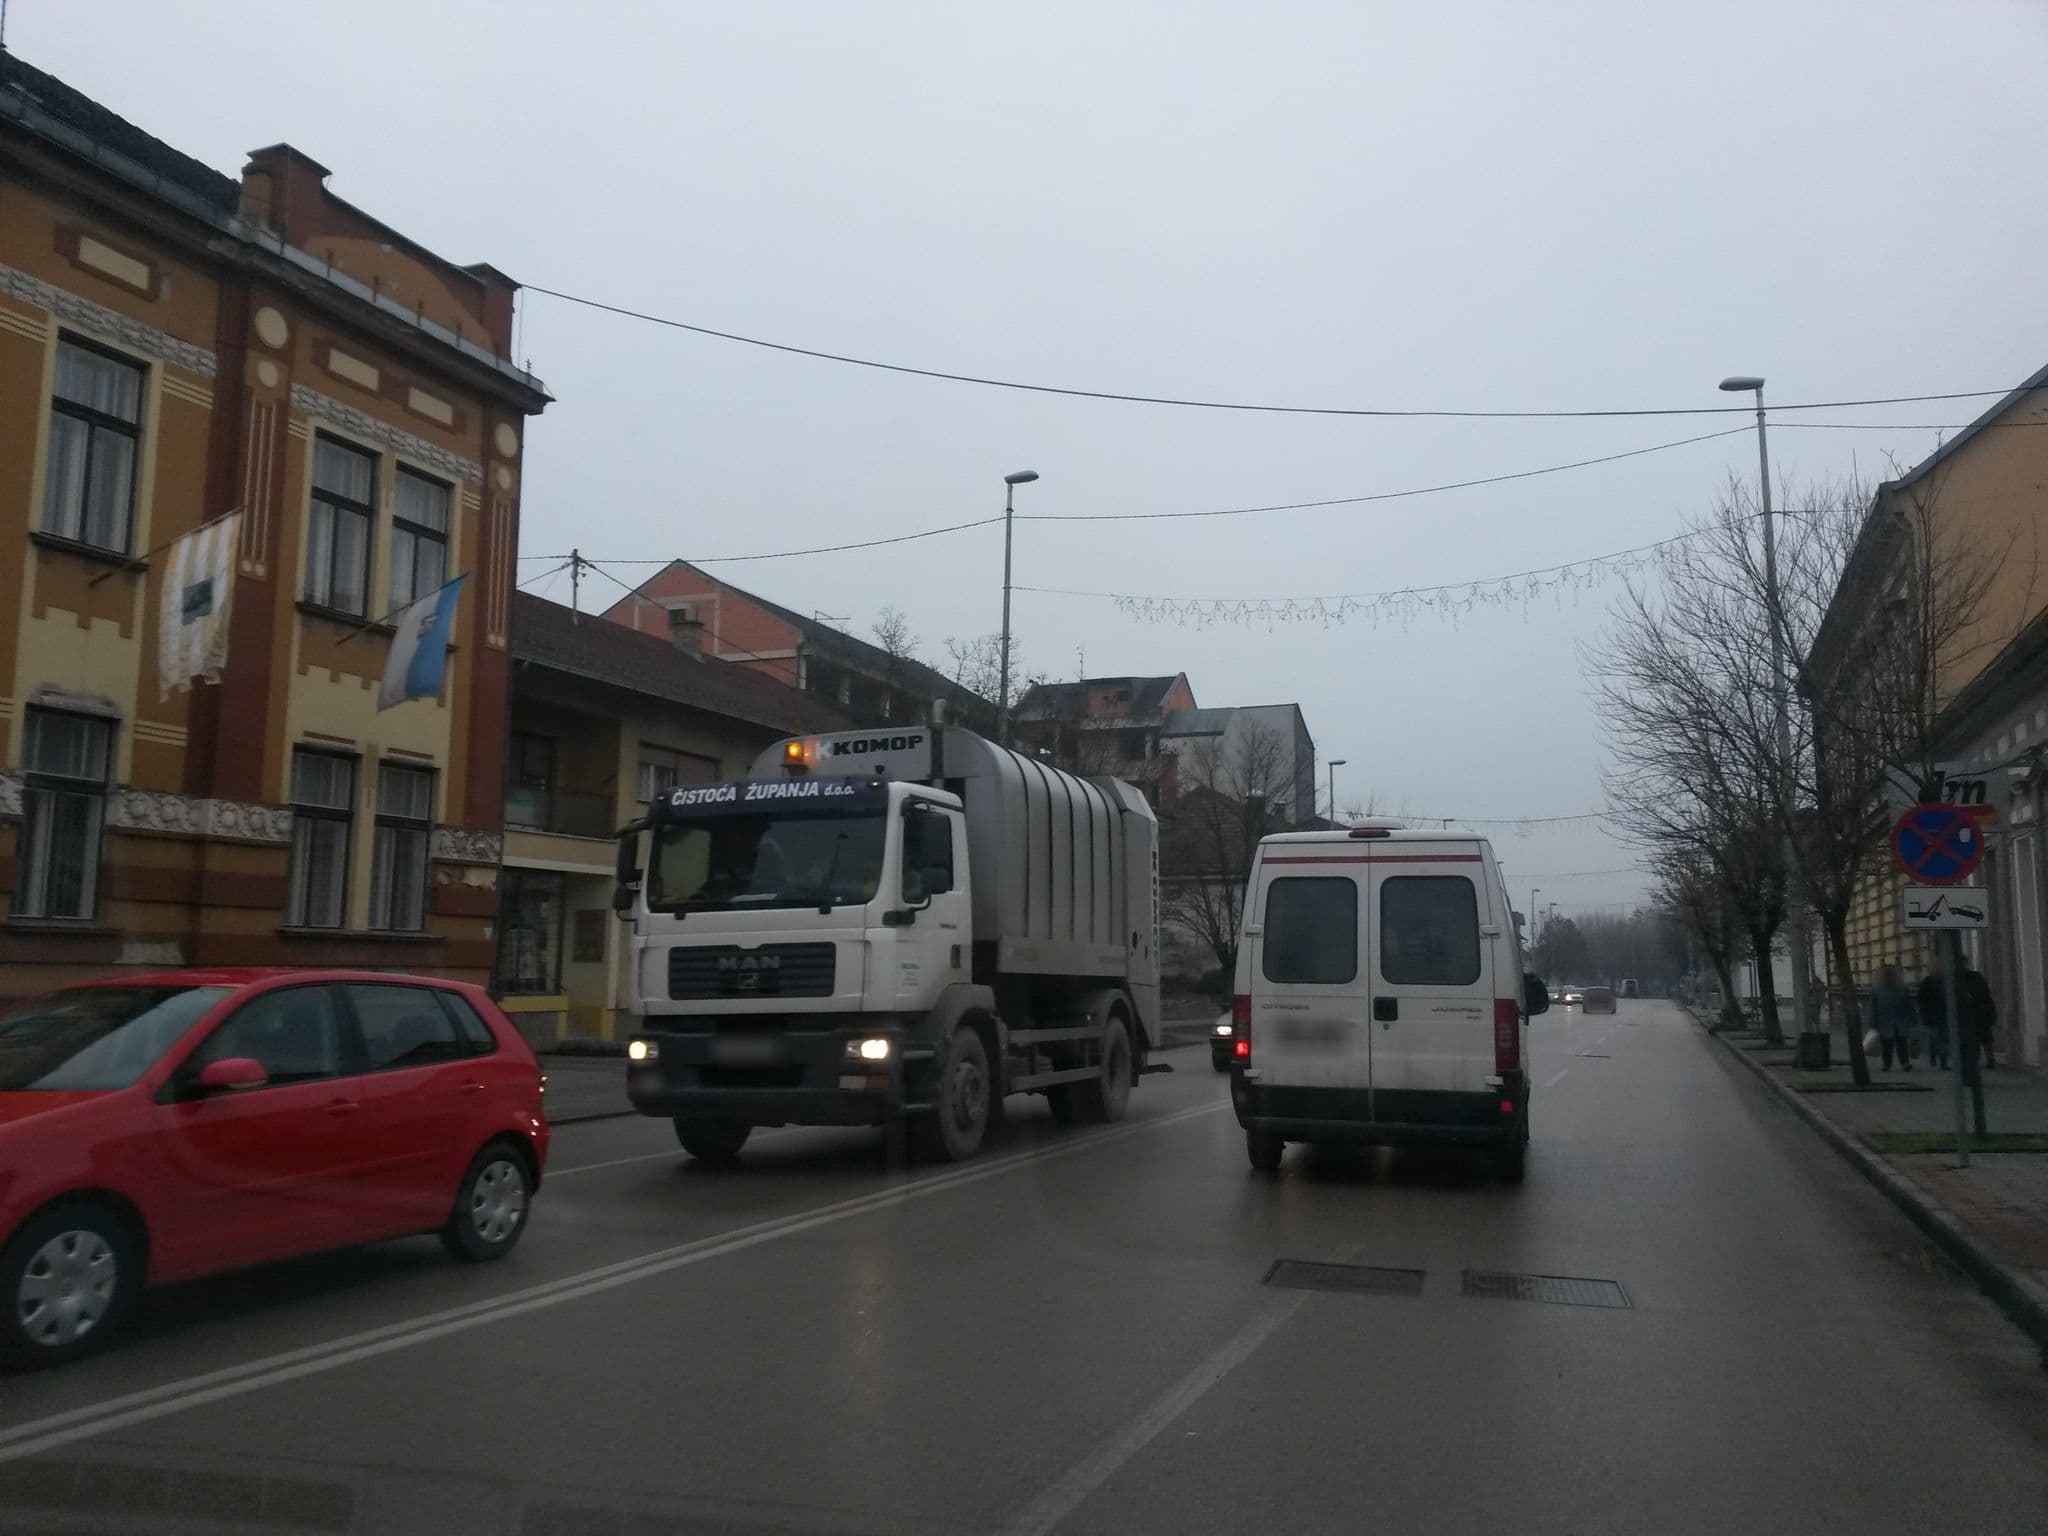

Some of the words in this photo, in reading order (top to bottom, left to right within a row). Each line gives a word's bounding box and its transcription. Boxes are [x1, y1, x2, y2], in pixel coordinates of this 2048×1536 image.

[833, 735, 923, 756] KOMOP
[671, 783, 737, 806] ČISTOĆA
[744, 781, 819, 801] ŽUPANJA
[824, 784, 855, 797] d.o.o.
[719, 955, 780, 970] MAN
